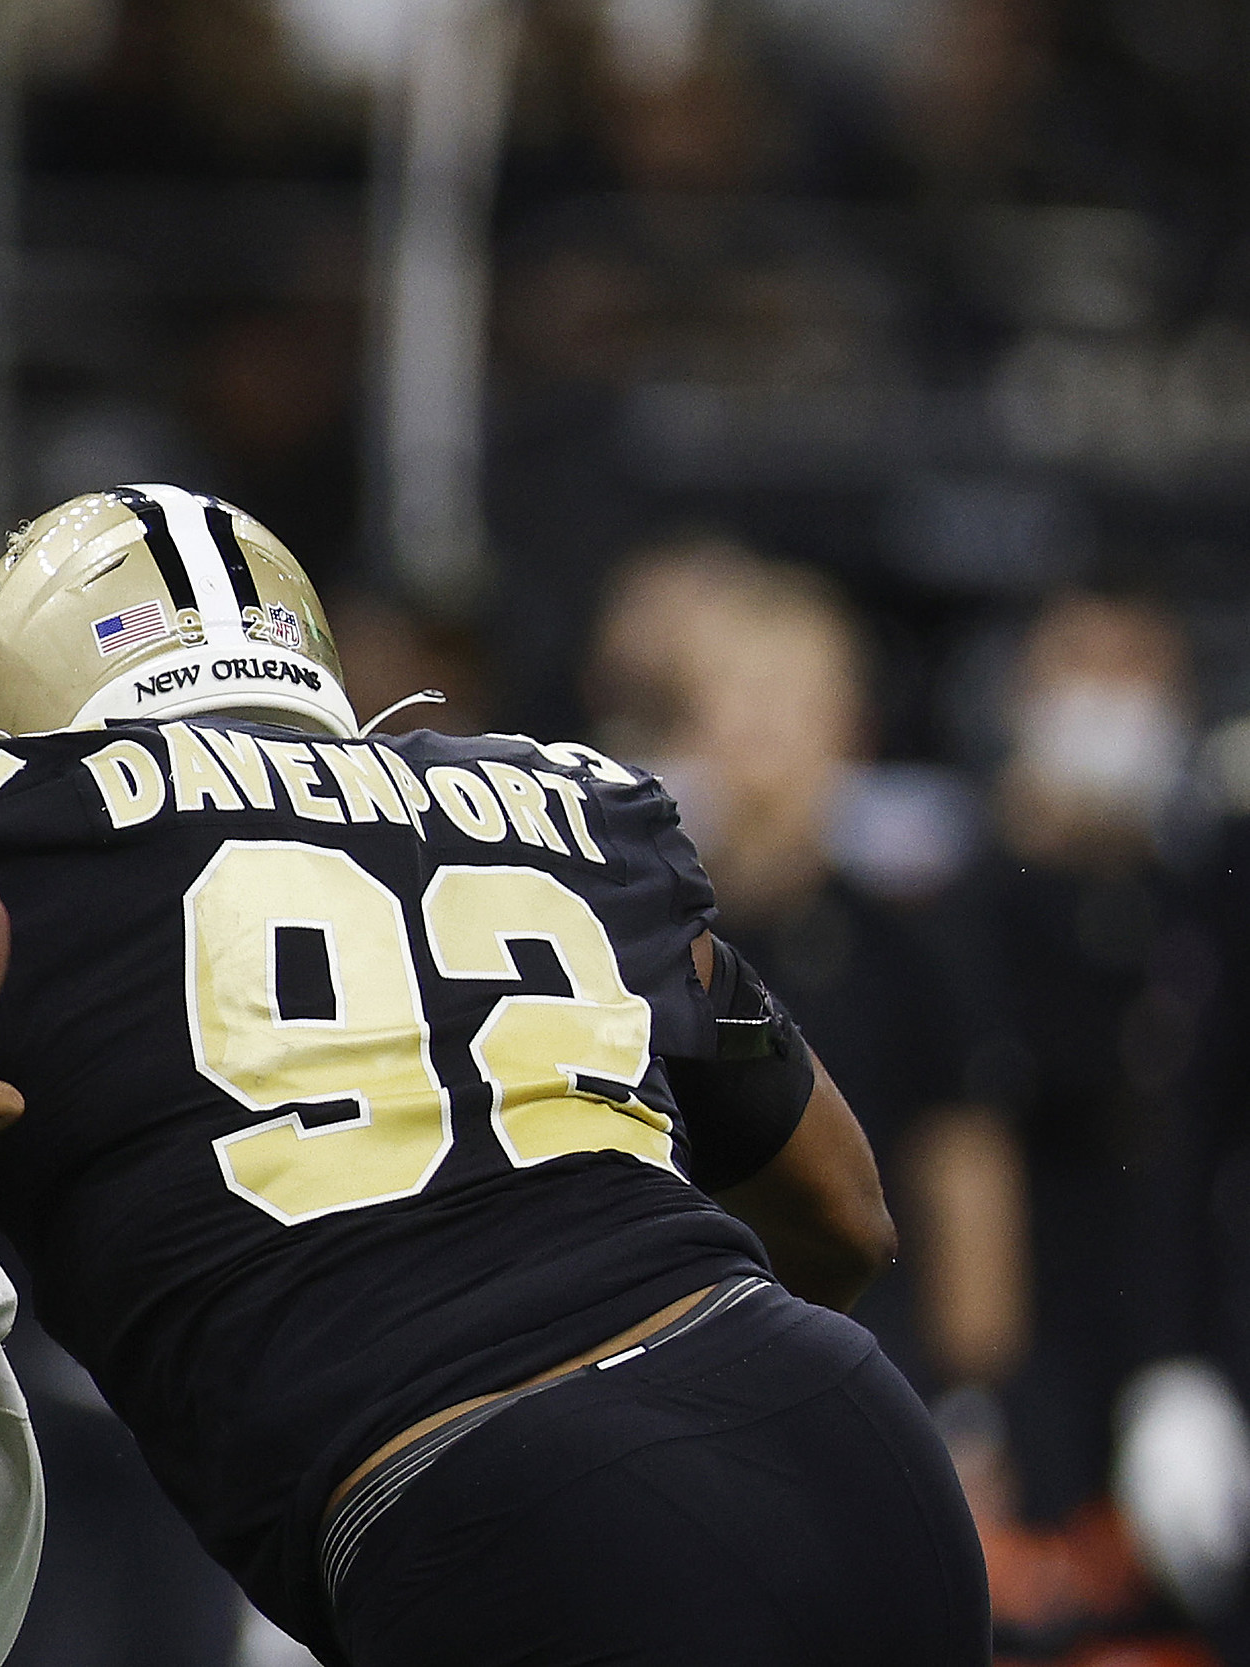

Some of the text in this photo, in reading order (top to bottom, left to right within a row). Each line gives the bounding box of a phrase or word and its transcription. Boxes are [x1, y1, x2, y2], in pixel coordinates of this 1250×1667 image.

[176, 605, 272, 648] 9 2
[276, 620, 299, 642] NFL
[134, 658, 322, 703] NEW ORLEANS
[82, 720, 607, 865] DAVENPORT
[183, 839, 690, 1226] 92
